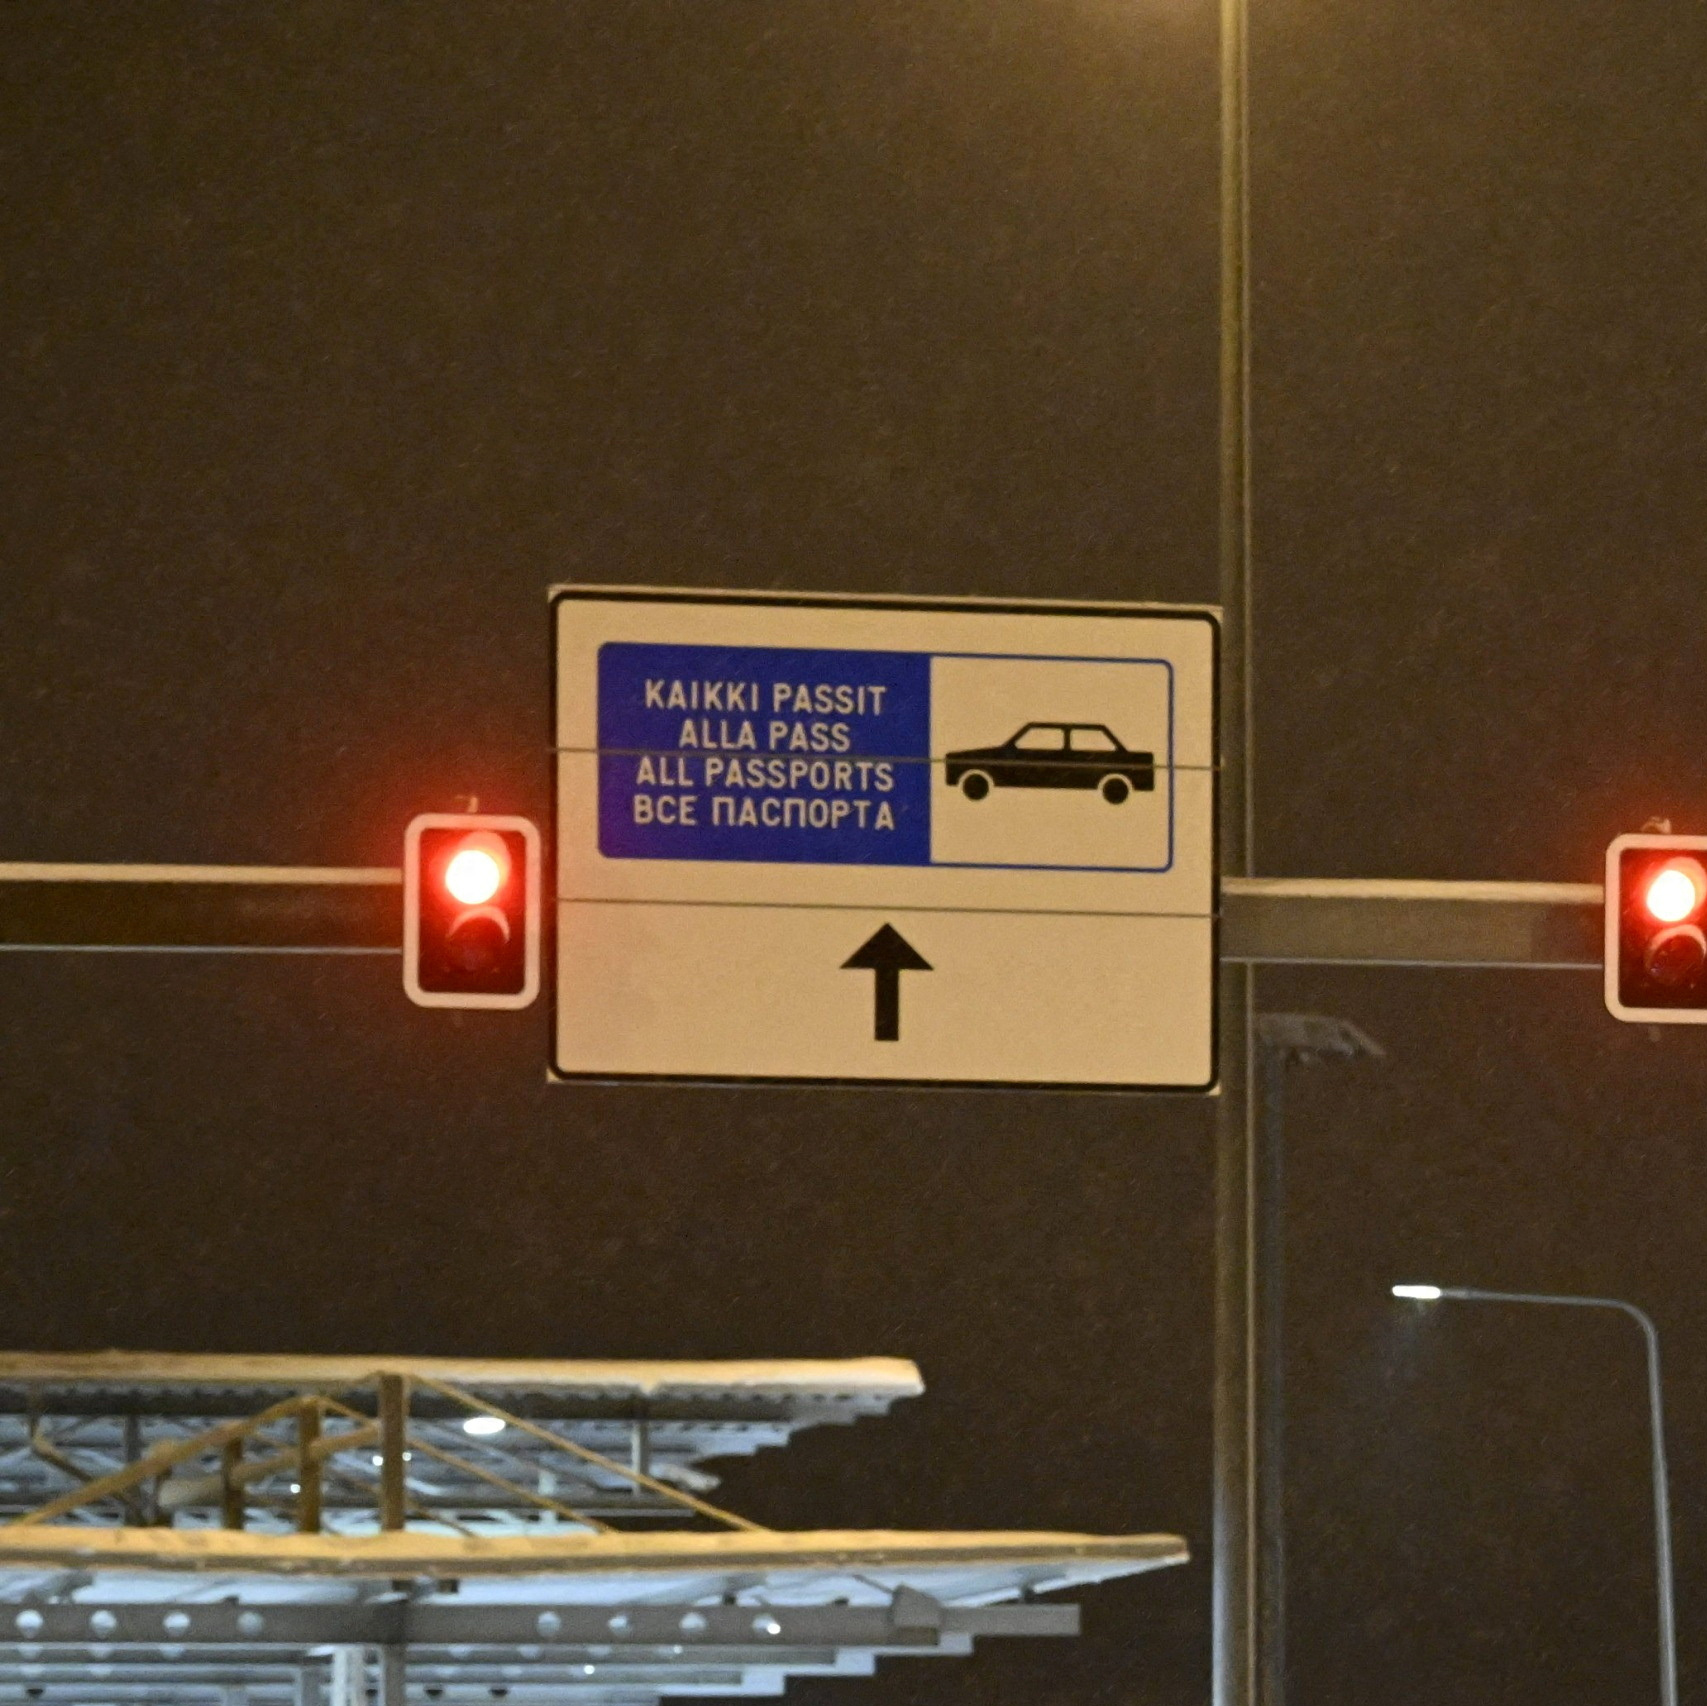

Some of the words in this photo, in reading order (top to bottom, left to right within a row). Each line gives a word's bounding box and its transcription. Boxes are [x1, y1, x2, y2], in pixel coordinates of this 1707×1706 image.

[645, 679, 758, 711] KAIKKI
[773, 682, 885, 714] PASSIT
[679, 718, 755, 749] ALLA
[769, 720, 850, 752] PASS
[636, 757, 693, 786] ALL
[705, 758, 893, 791] PASSPORTS
[633, 793, 696, 825] ВСЕ
[712, 796, 893, 829] ПАСПОРТА
